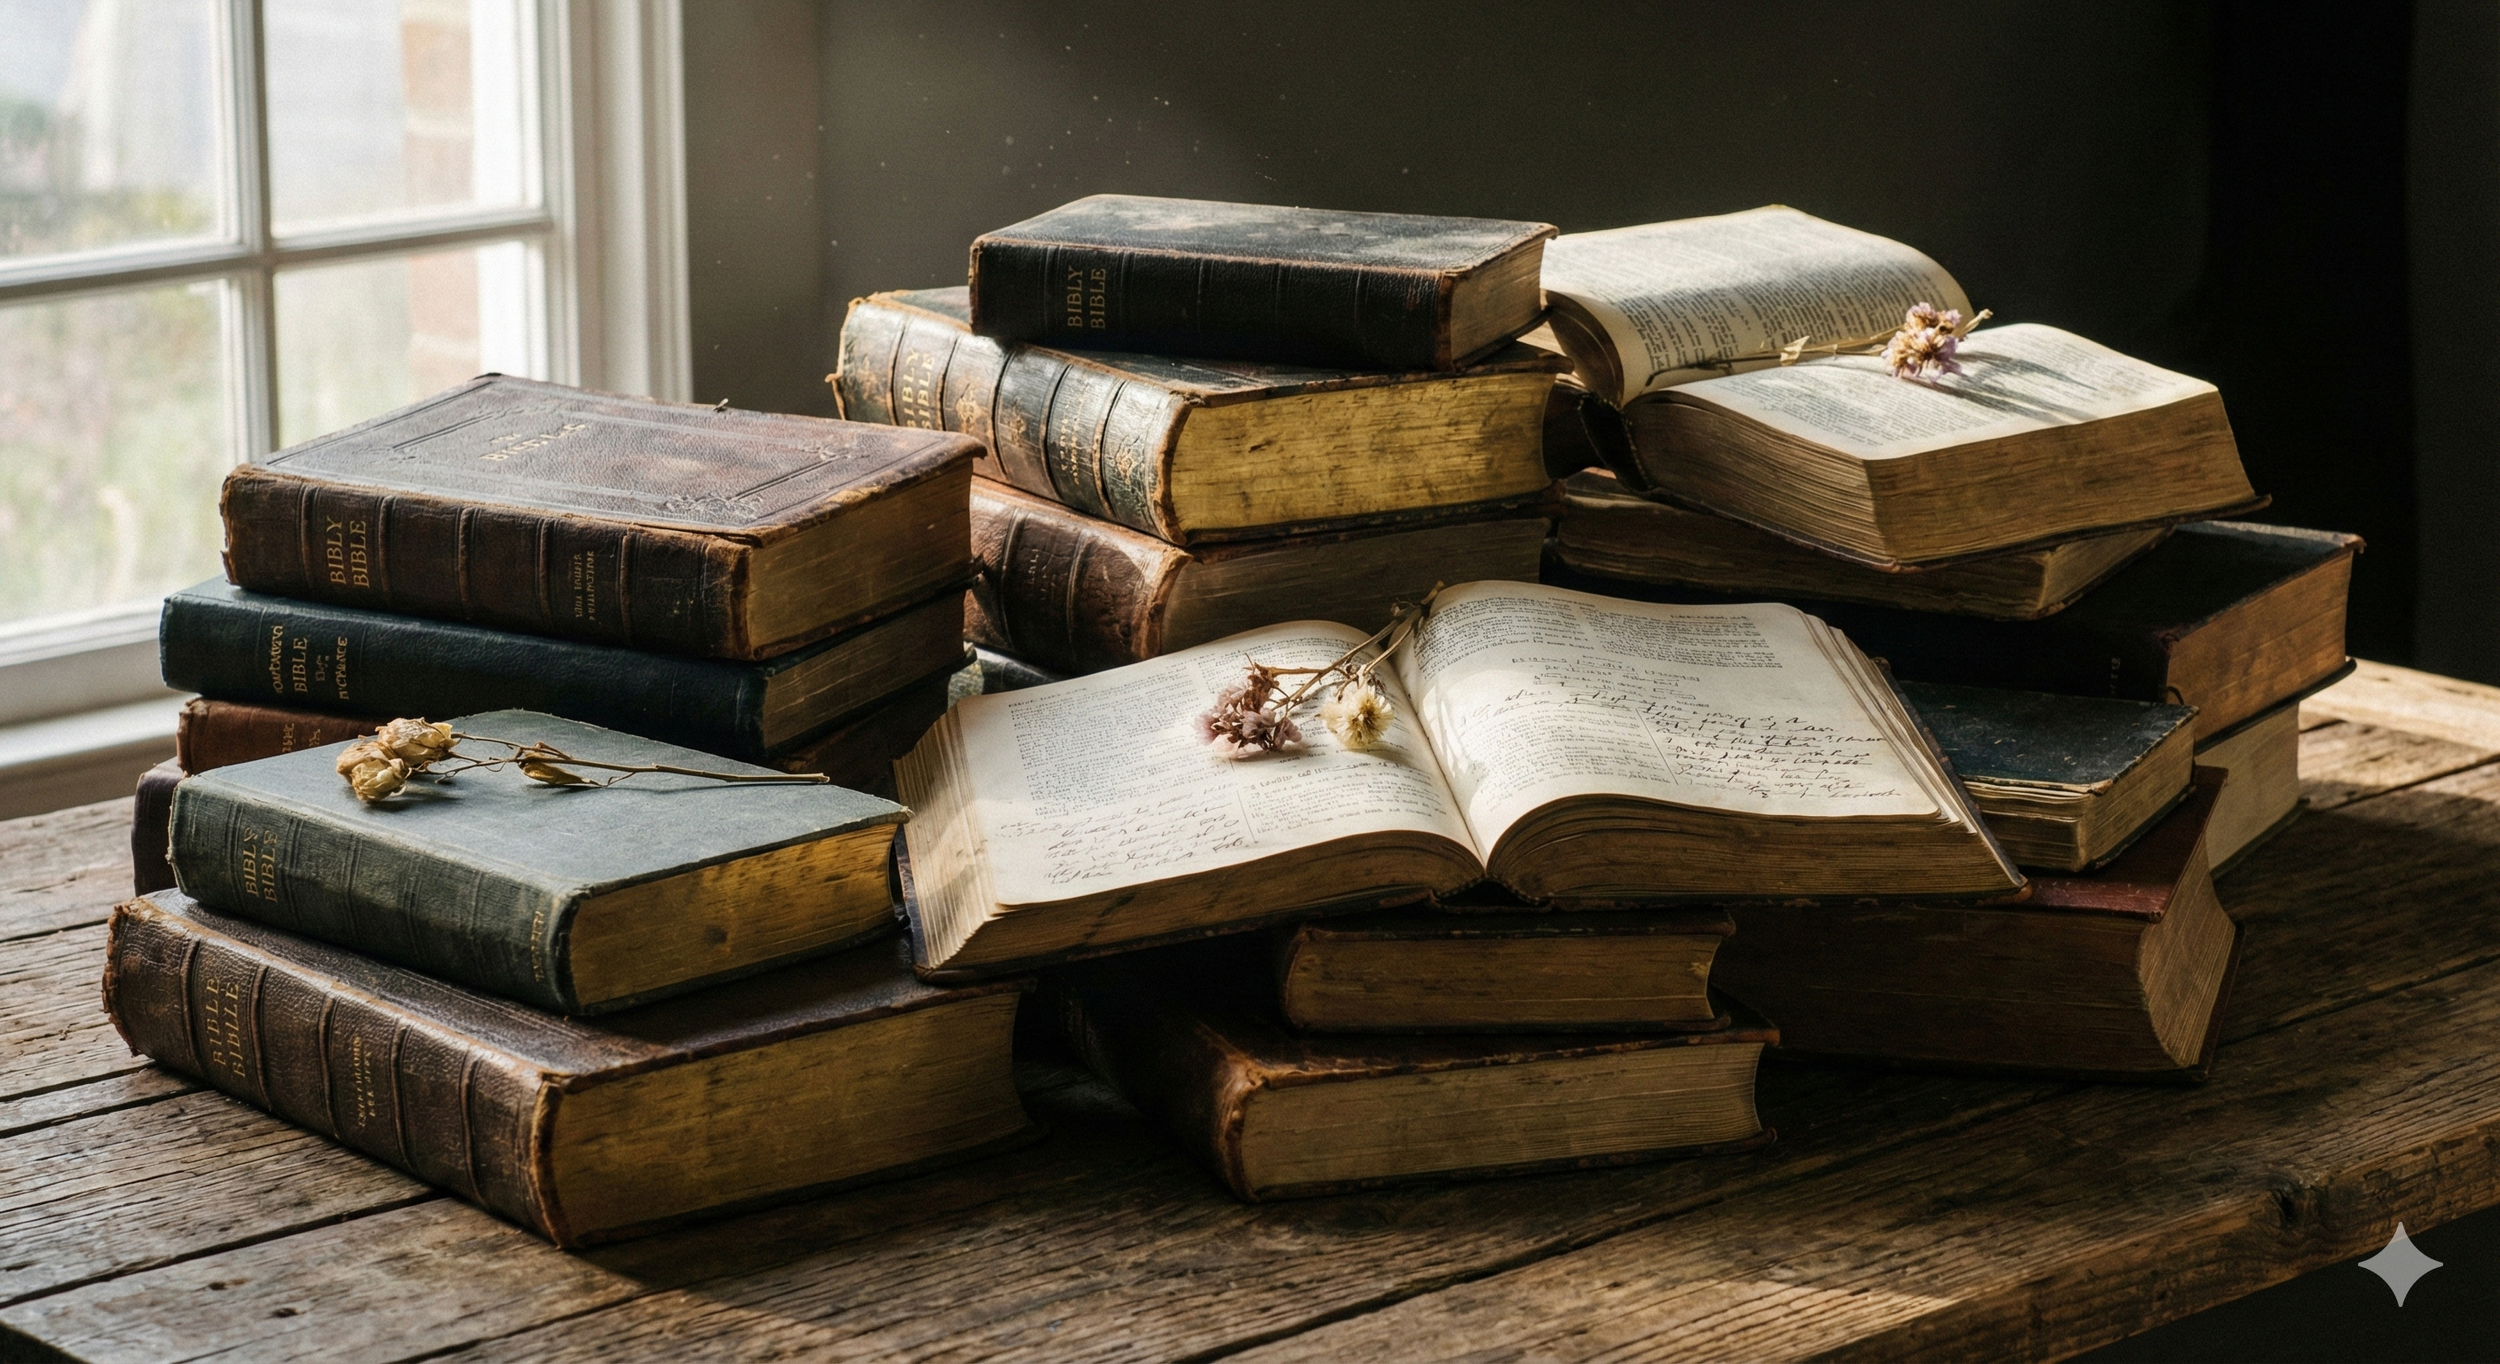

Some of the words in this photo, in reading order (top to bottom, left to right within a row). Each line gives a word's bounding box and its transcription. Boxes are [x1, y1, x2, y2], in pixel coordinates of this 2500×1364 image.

[1067, 265, 1083, 328] BIBLY
[1090, 268, 1106, 329] BIBLE
[326, 514, 347, 585] BIBLY
[349, 520, 370, 588] BIBLE
[292, 637, 308, 692] BIBLE
